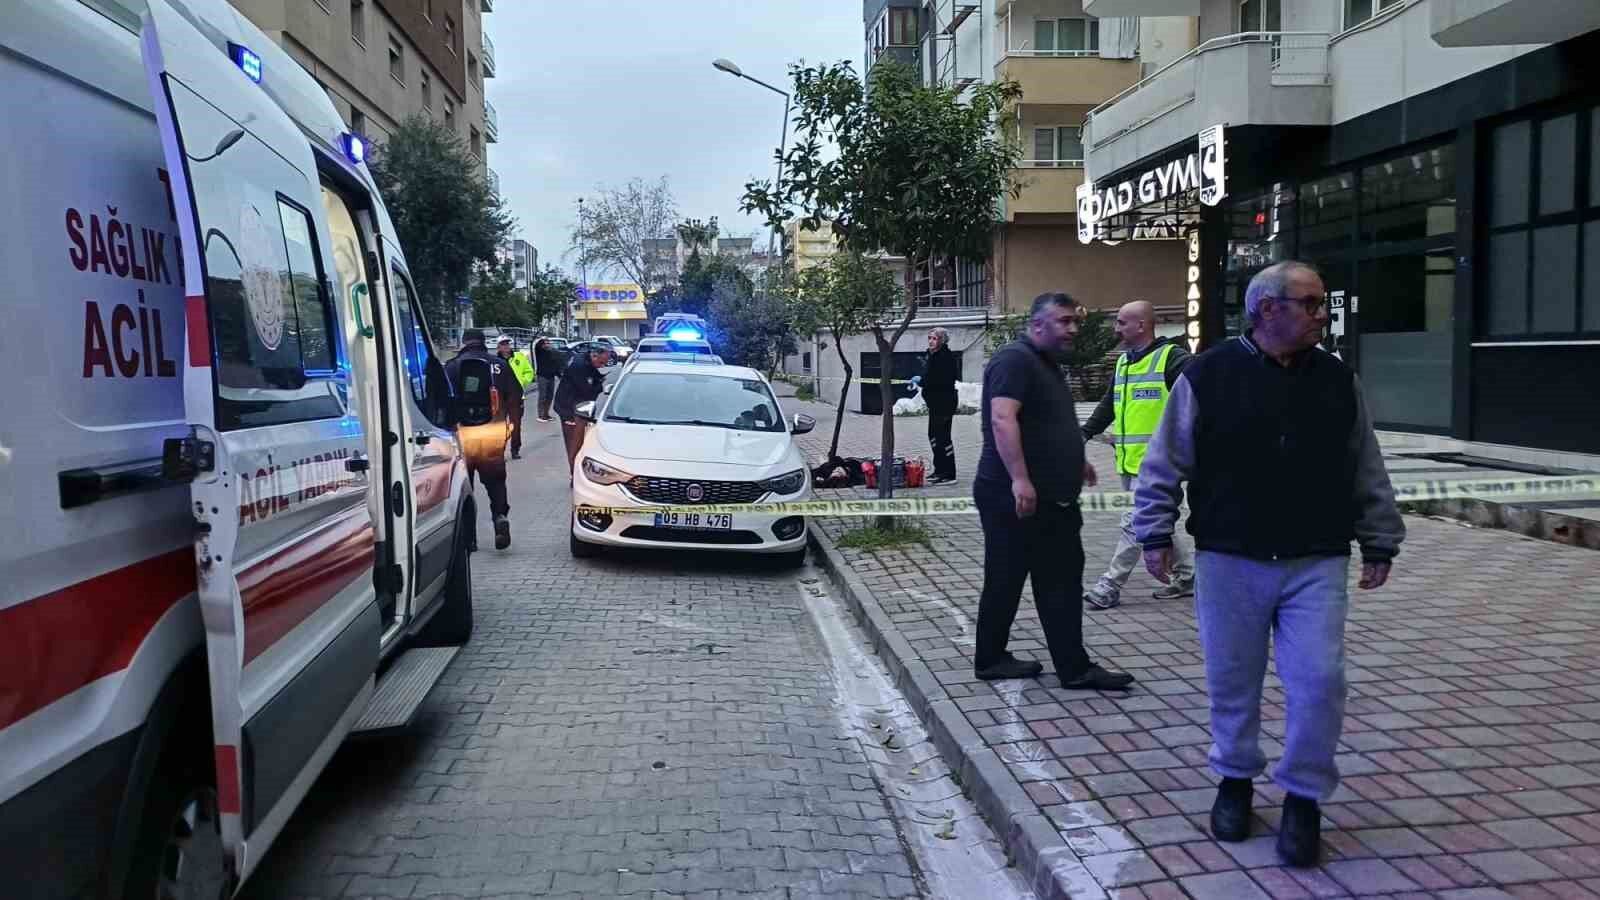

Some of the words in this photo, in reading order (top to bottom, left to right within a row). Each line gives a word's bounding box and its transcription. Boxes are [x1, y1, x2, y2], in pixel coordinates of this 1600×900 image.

[1089, 180, 1133, 224] DAD
[1139, 154, 1200, 204] GYM
[66, 205, 171, 286] SAĞLIK
[83, 289, 176, 378] ACİL
[663, 512, 679, 525] 09
[685, 513, 700, 526] HB
[706, 514, 729, 528] 476
